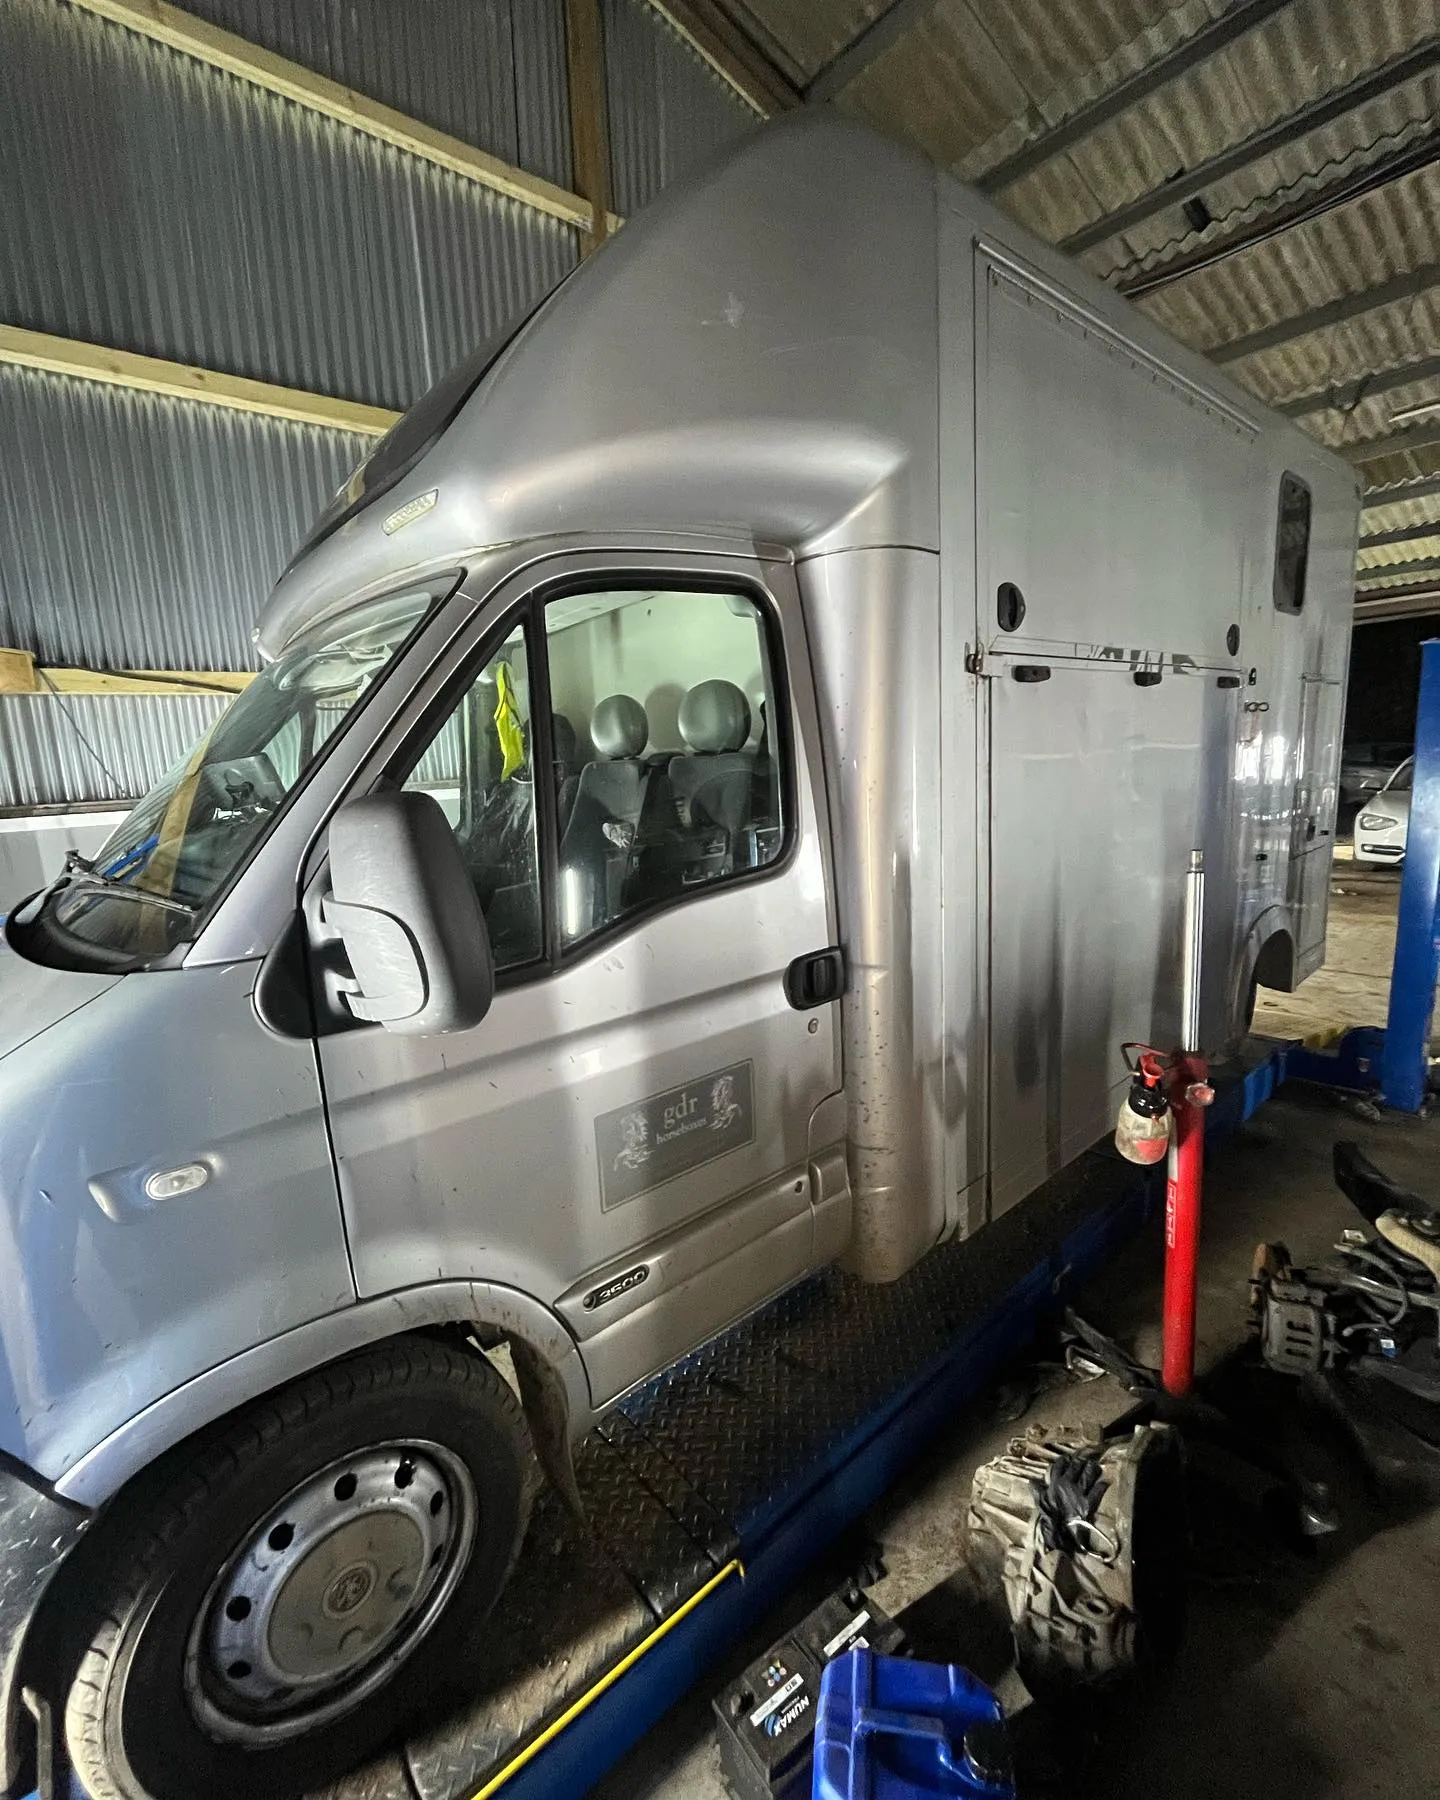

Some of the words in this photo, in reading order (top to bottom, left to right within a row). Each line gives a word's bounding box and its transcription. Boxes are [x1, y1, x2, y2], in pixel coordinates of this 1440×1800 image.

[664, 1093, 698, 1129] gdr
[600, 1271, 645, 1302] 3500
[774, 1696, 810, 1736] NUMAX
